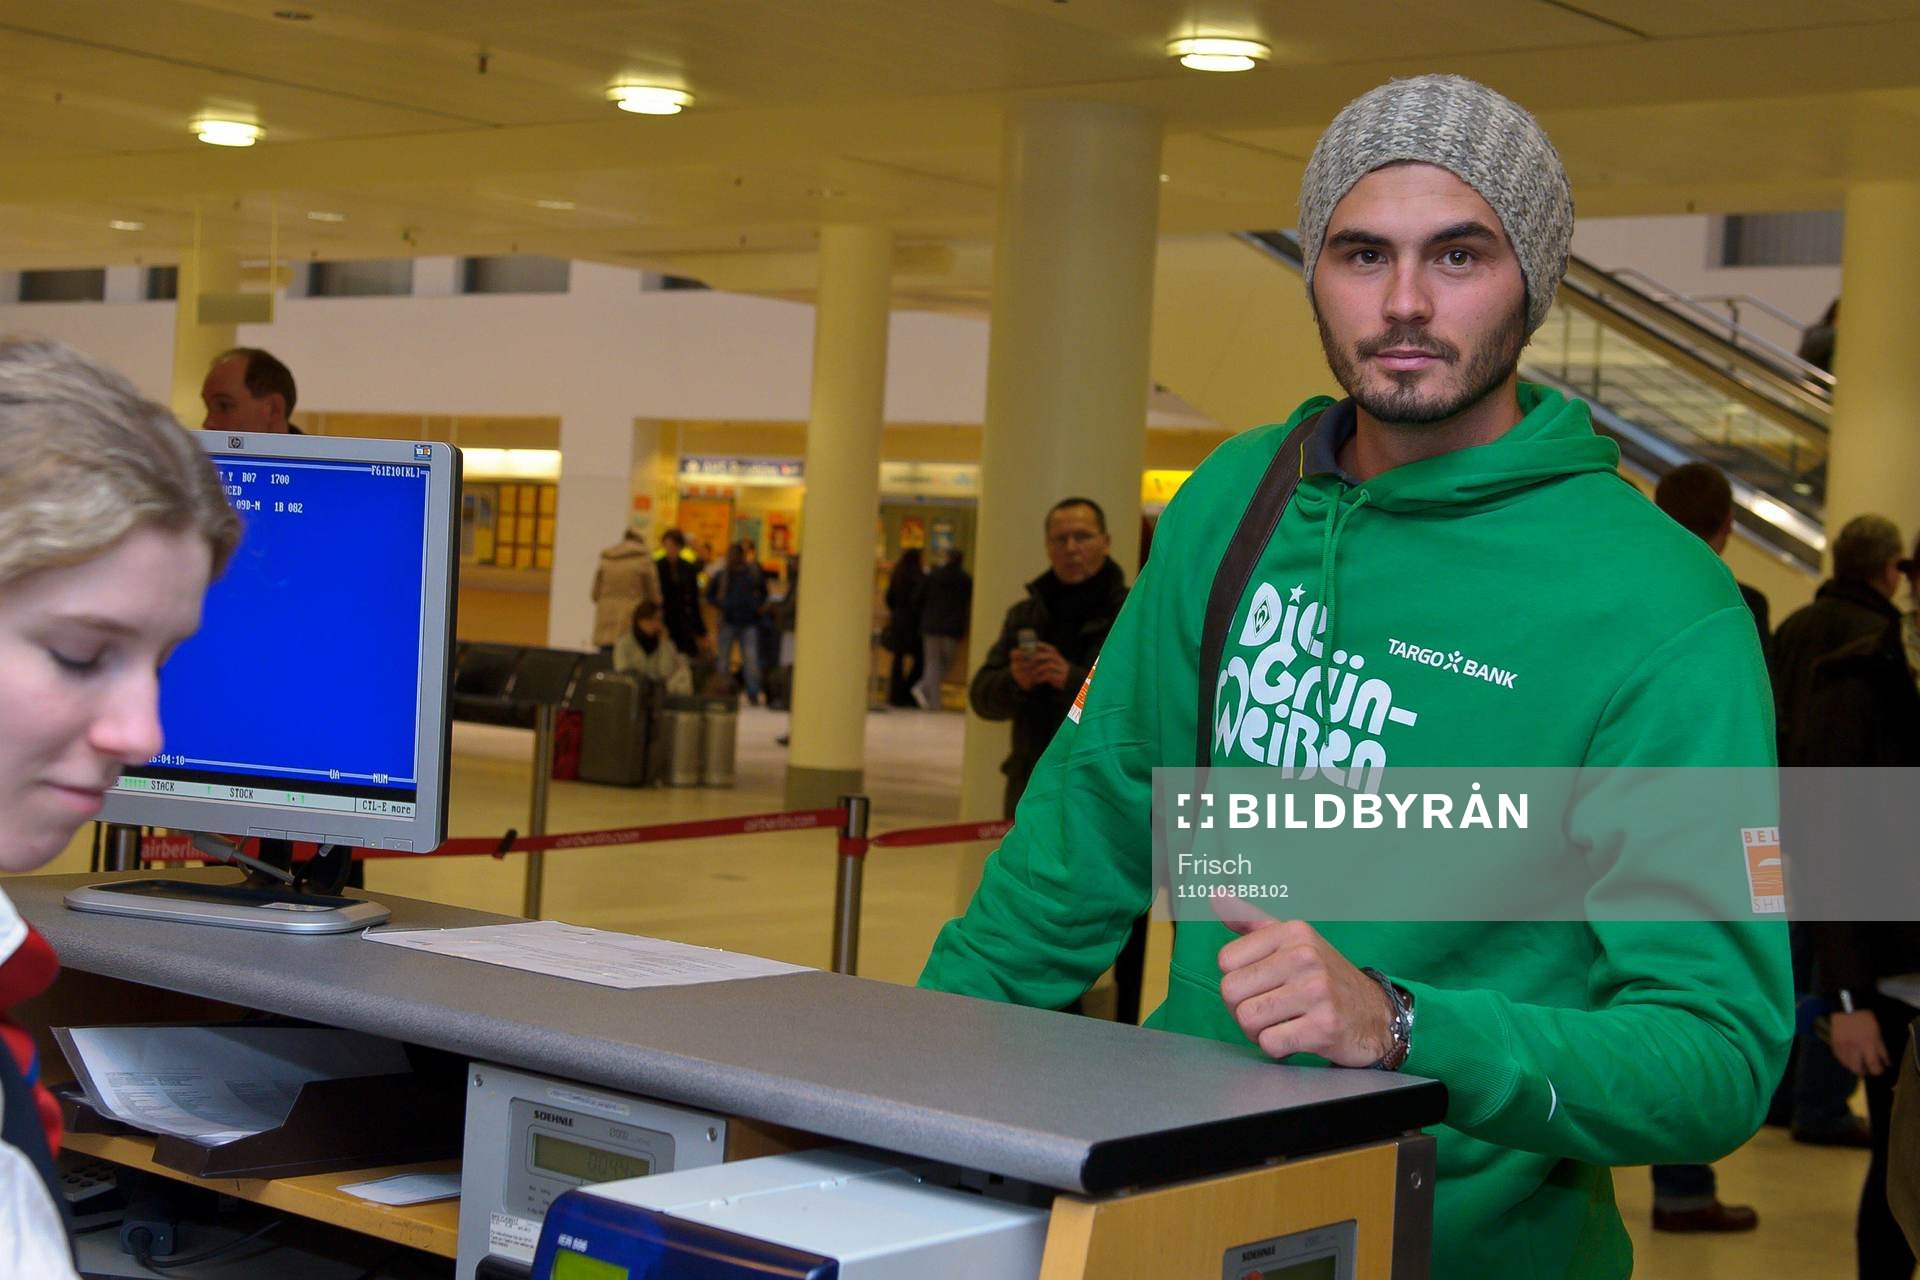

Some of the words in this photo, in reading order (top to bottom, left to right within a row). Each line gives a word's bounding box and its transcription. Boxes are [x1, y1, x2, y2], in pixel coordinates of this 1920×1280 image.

[242, 473, 257, 483] B07
[271, 474, 290, 485] 1700
[1239, 582, 1328, 658] Die
[372, 773, 389, 784] NUM
[151, 780, 174, 792] STACK
[230, 788, 254, 799] STOCK
[362, 800, 387, 812] CTL-E
[391, 805, 411, 814] more
[1744, 830, 1779, 843] BEL
[533, 1109, 574, 1127] SOEHNLE
